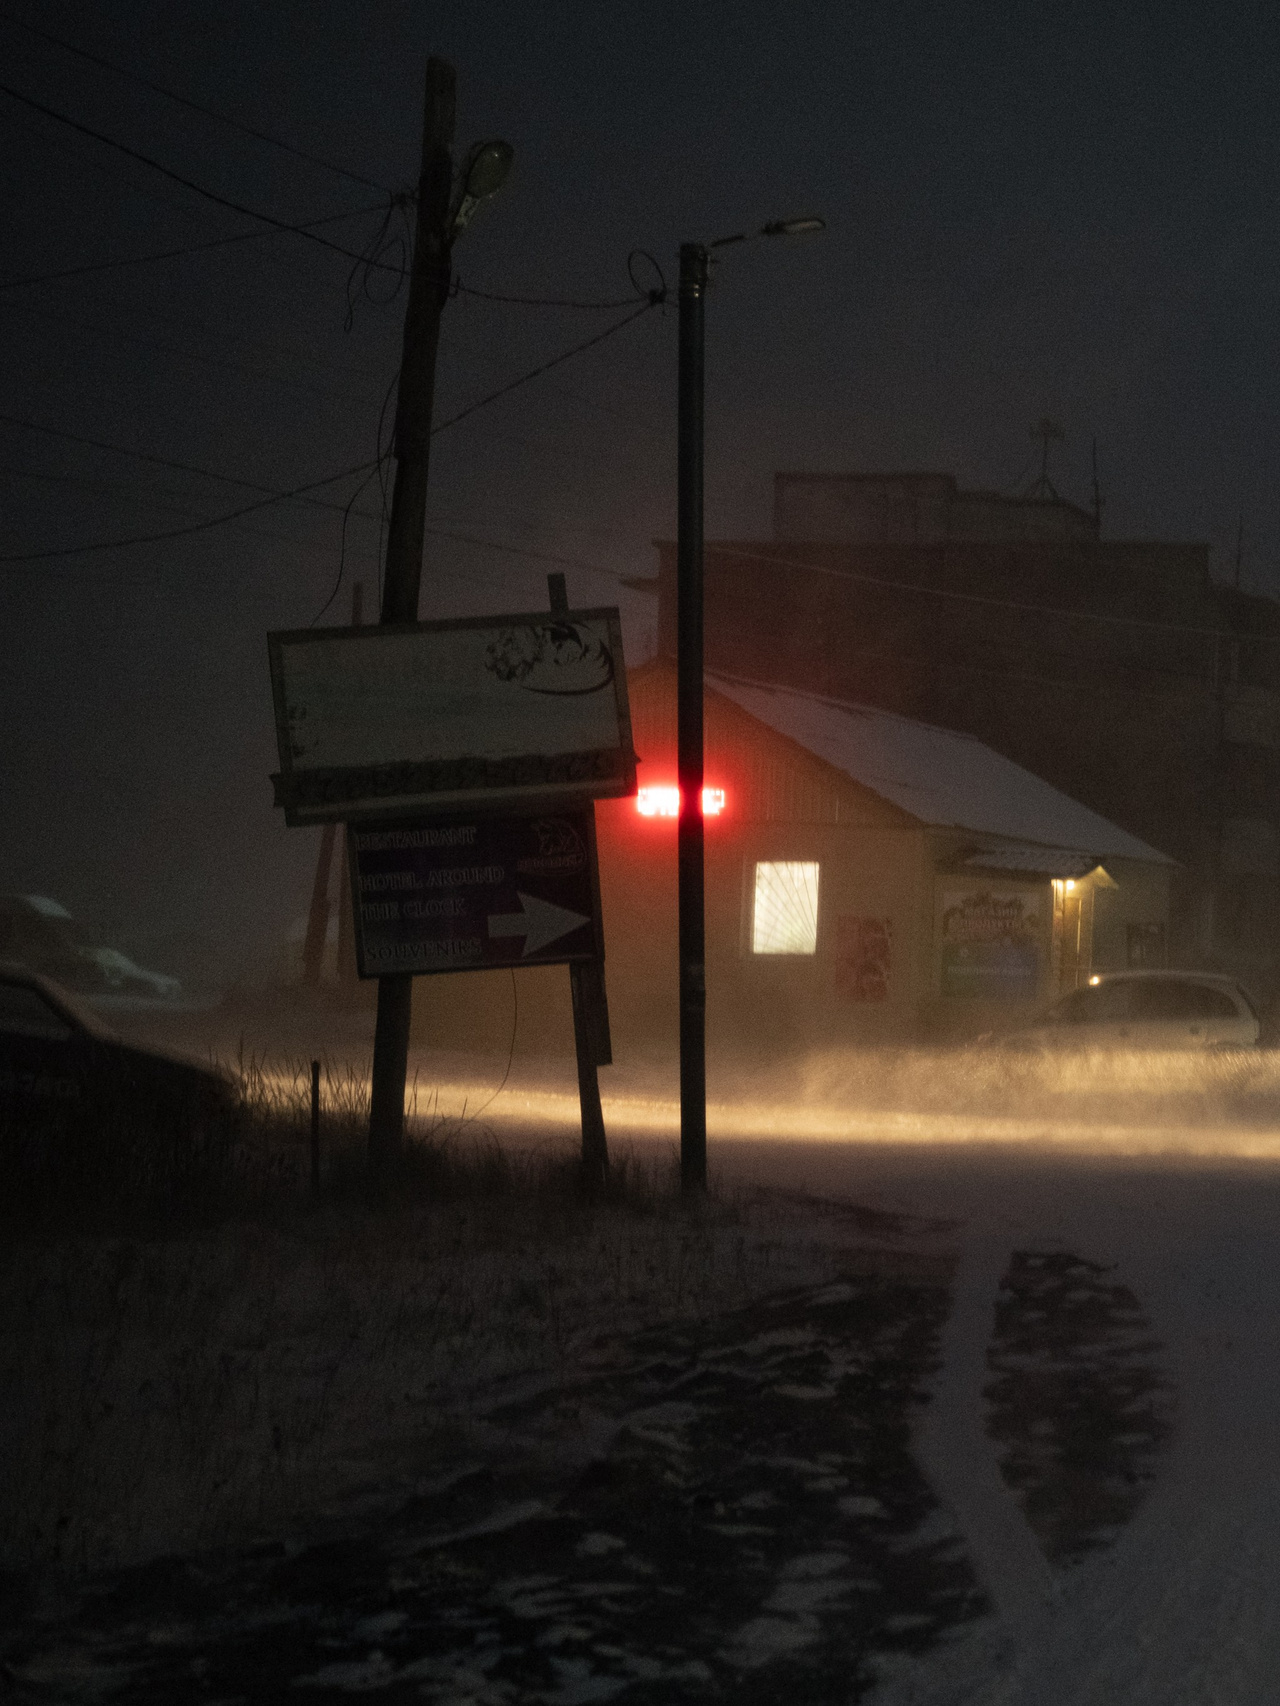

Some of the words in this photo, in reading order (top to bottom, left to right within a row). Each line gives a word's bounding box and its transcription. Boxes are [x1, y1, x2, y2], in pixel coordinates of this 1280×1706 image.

[356, 826, 476, 850] RESTAURANT
[359, 871, 422, 891] HOTEL
[427, 865, 505, 887] AROUND
[362, 901, 400, 921] THE
[403, 898, 466, 918] CLOCK
[367, 937, 482, 961] SOUVENIRS
